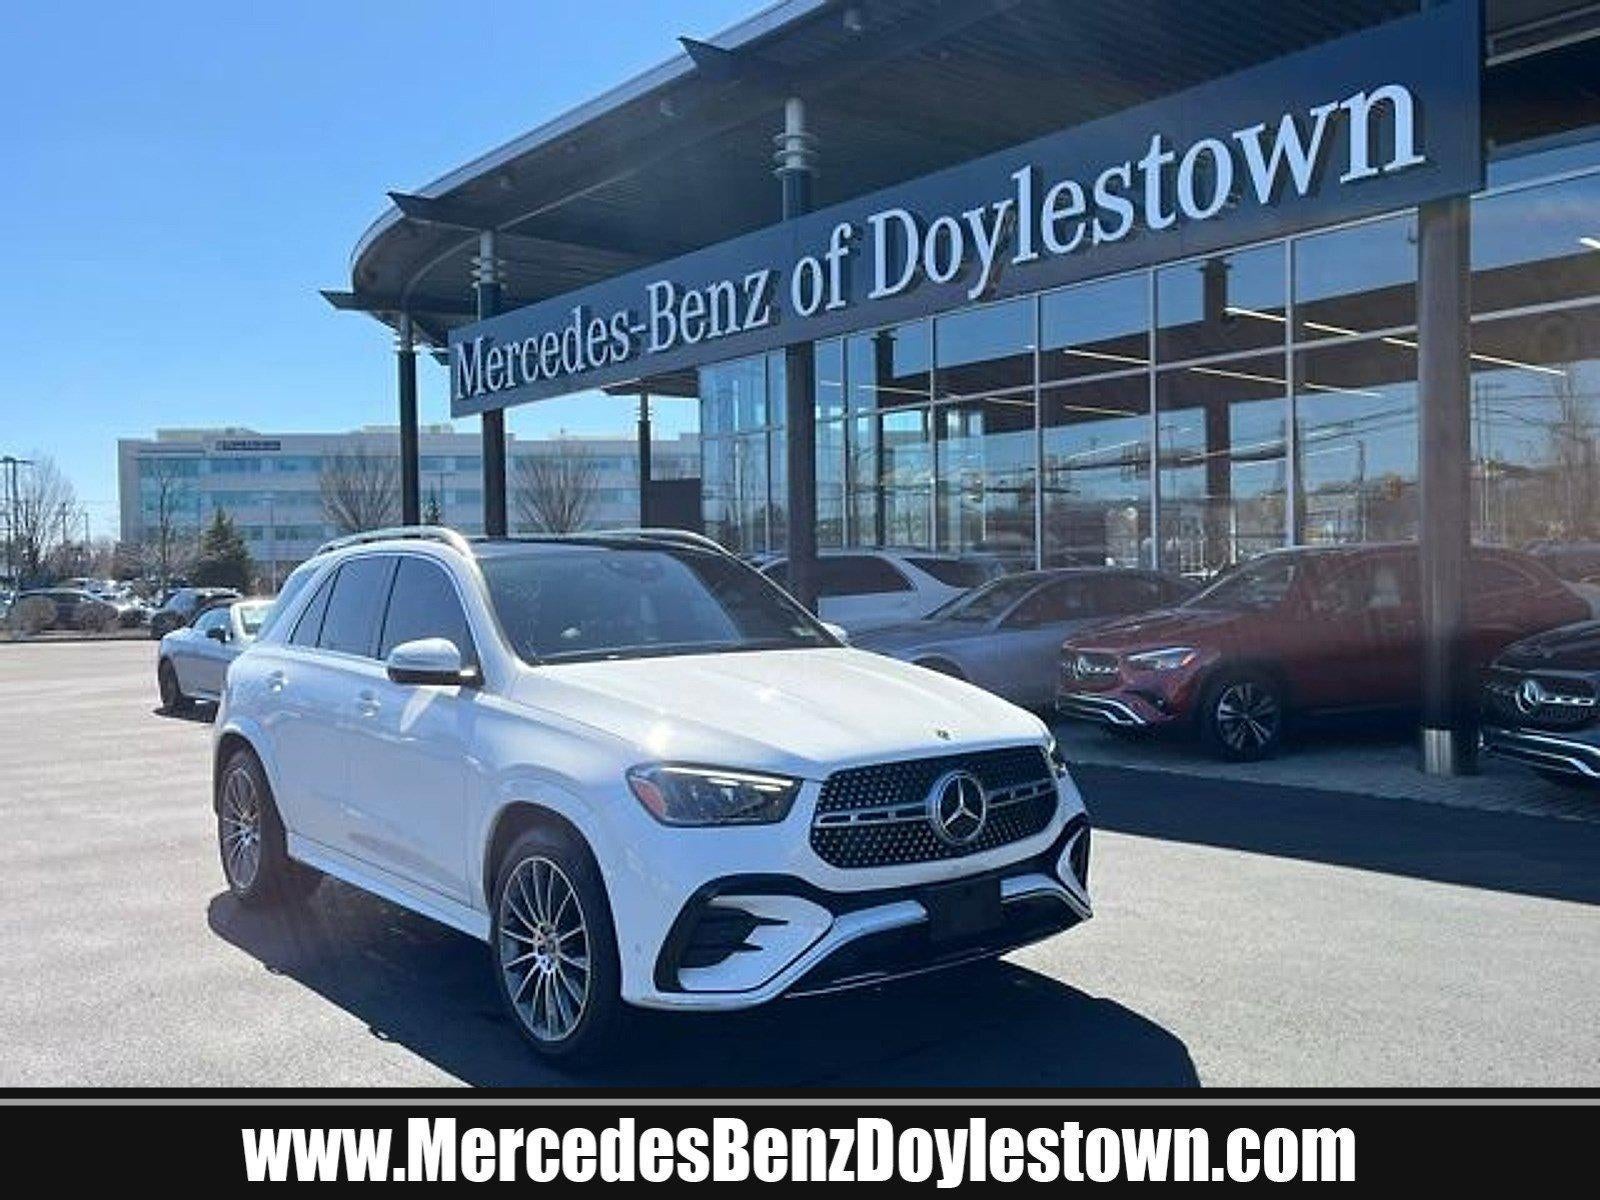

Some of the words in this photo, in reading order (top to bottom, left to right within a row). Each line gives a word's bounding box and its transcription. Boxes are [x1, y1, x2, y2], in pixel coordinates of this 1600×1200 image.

[455, 268, 771, 400] Mercedes-Benz
[791, 223, 853, 318] of
[867, 82, 1426, 301] Doylestown
